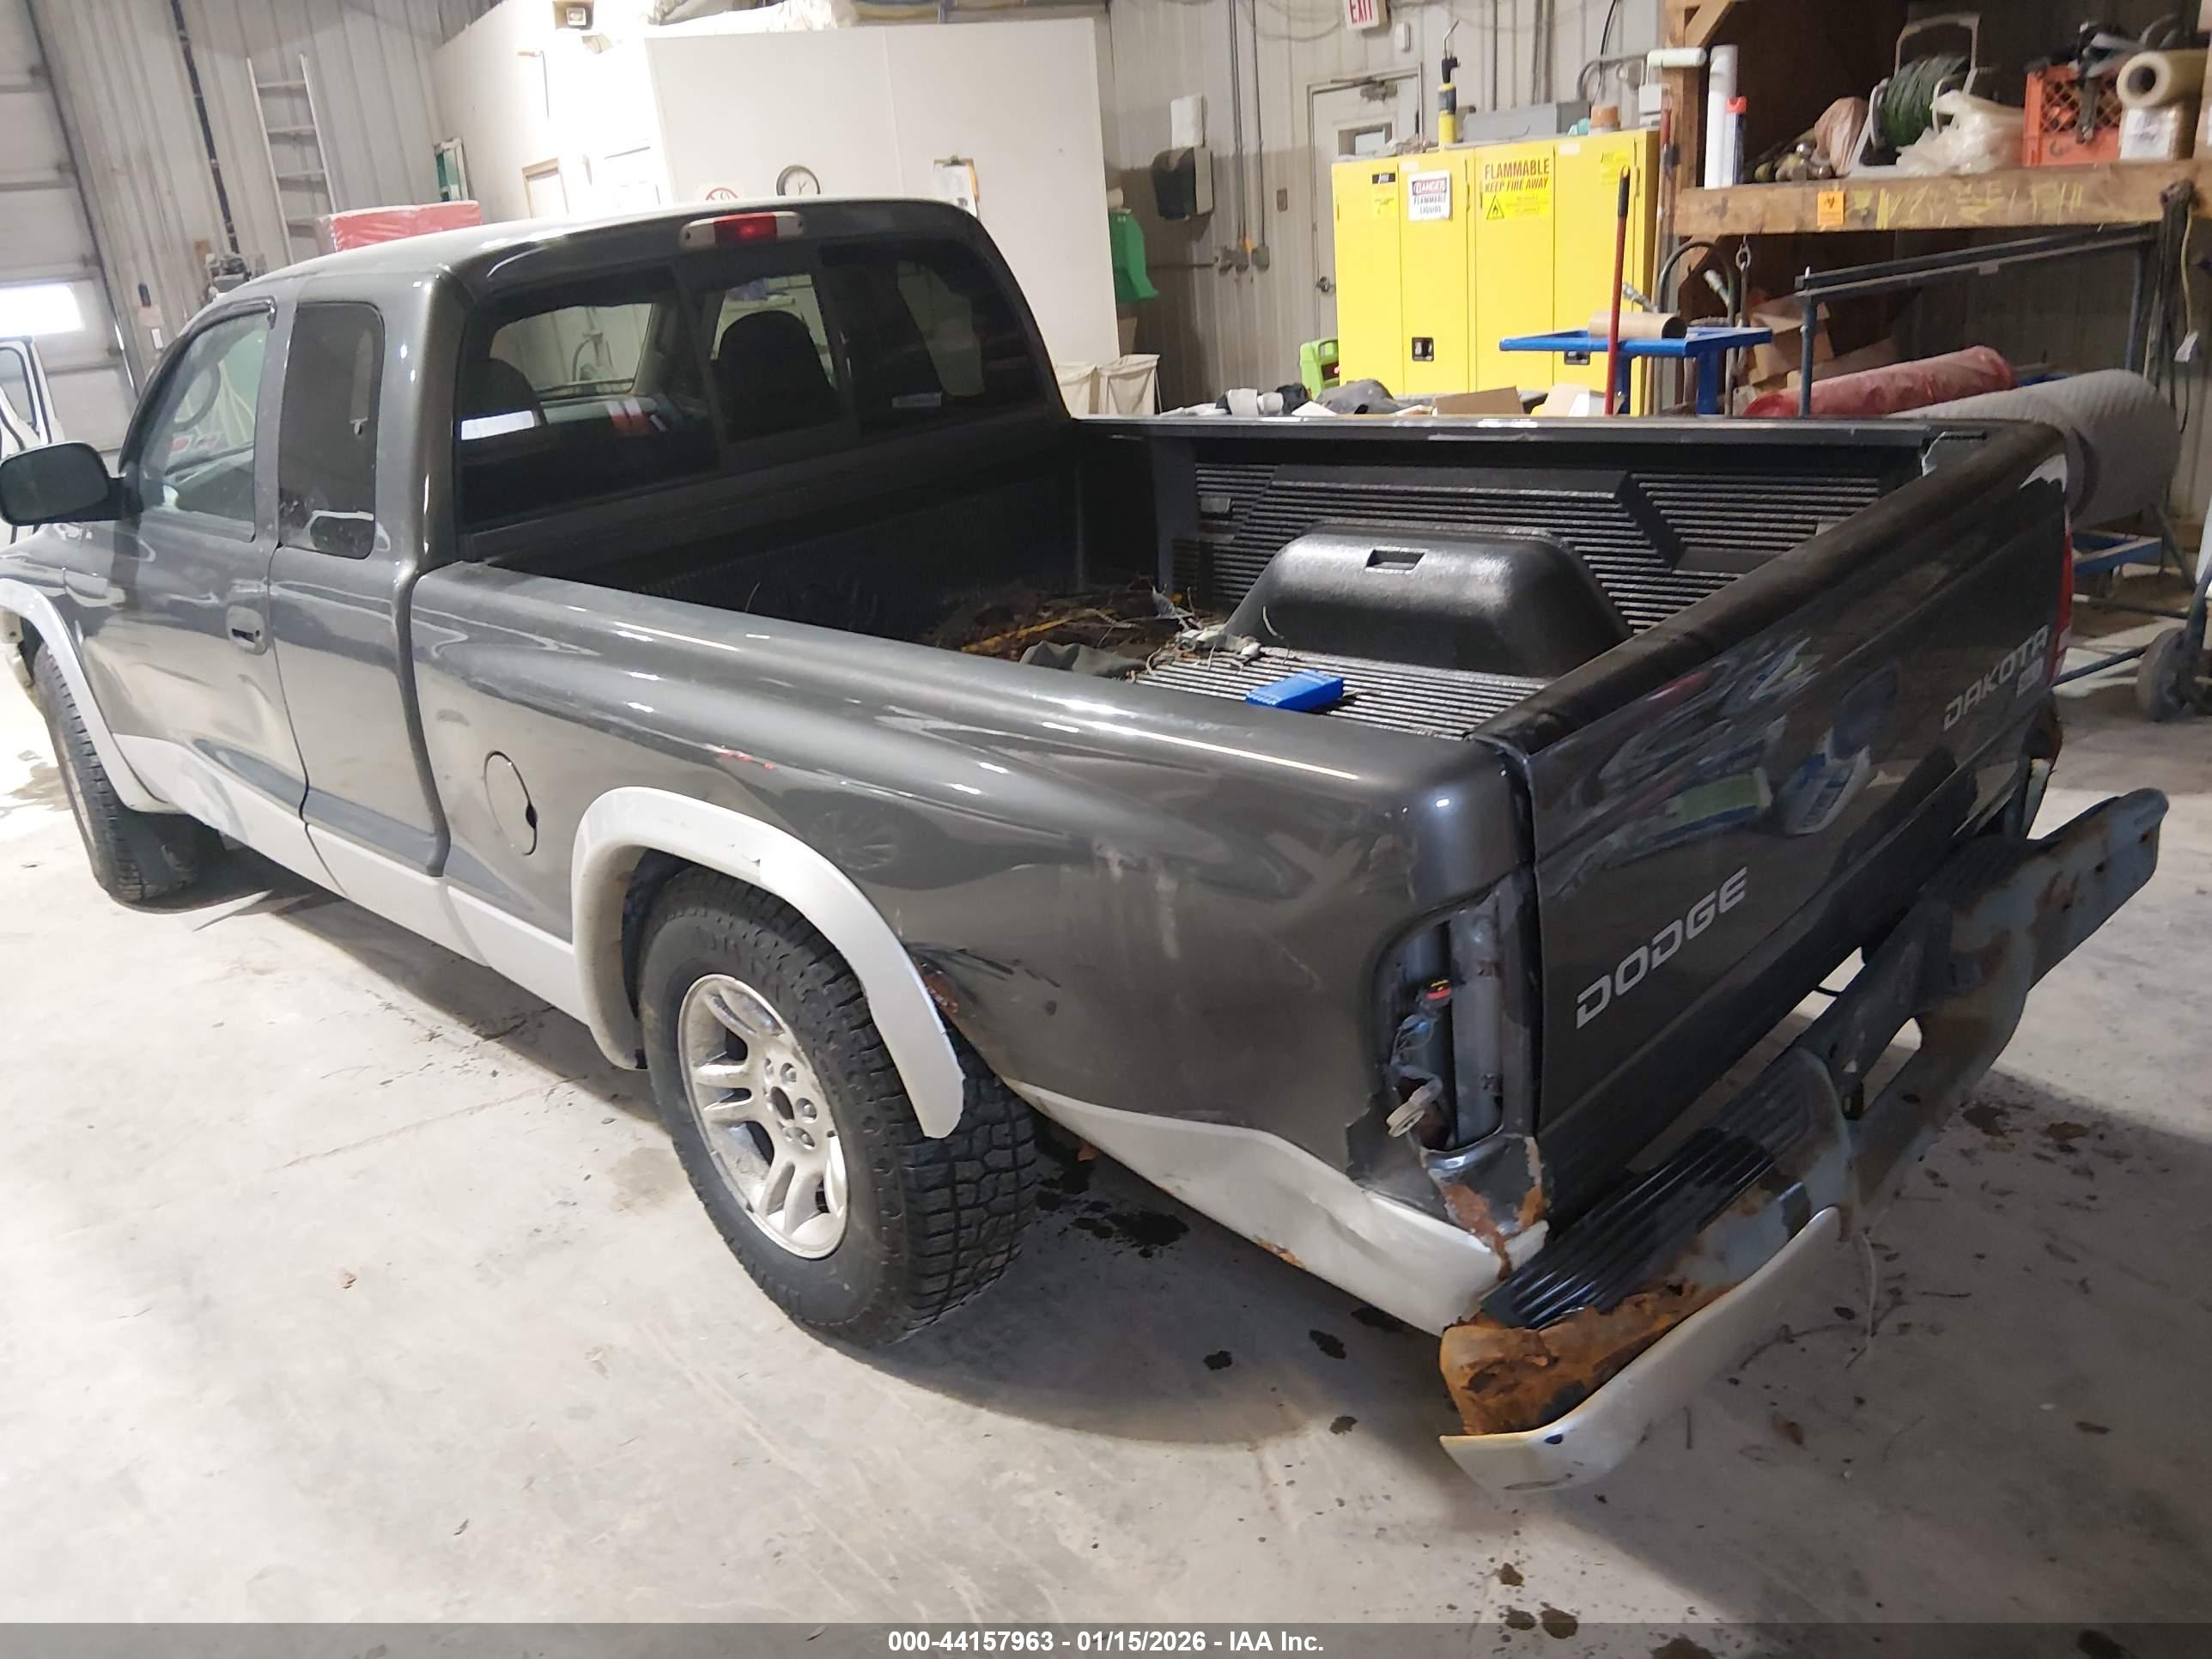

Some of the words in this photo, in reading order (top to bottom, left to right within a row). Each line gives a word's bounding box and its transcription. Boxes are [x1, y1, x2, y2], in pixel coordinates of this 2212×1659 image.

[1485, 158, 1549, 179] FLAMMABLE
[1413, 179, 1446, 194] DANGER
[1485, 181, 1504, 193] KEEP
[1506, 179, 1523, 192] FIRE
[1525, 176, 1549, 191] AWAY
[1413, 193, 1447, 206] FLAMMABLE
[1419, 205, 1442, 215] LIQUIDS
[1944, 624, 2049, 732] DAKOTA
[1577, 866, 1747, 1030] DODGE
